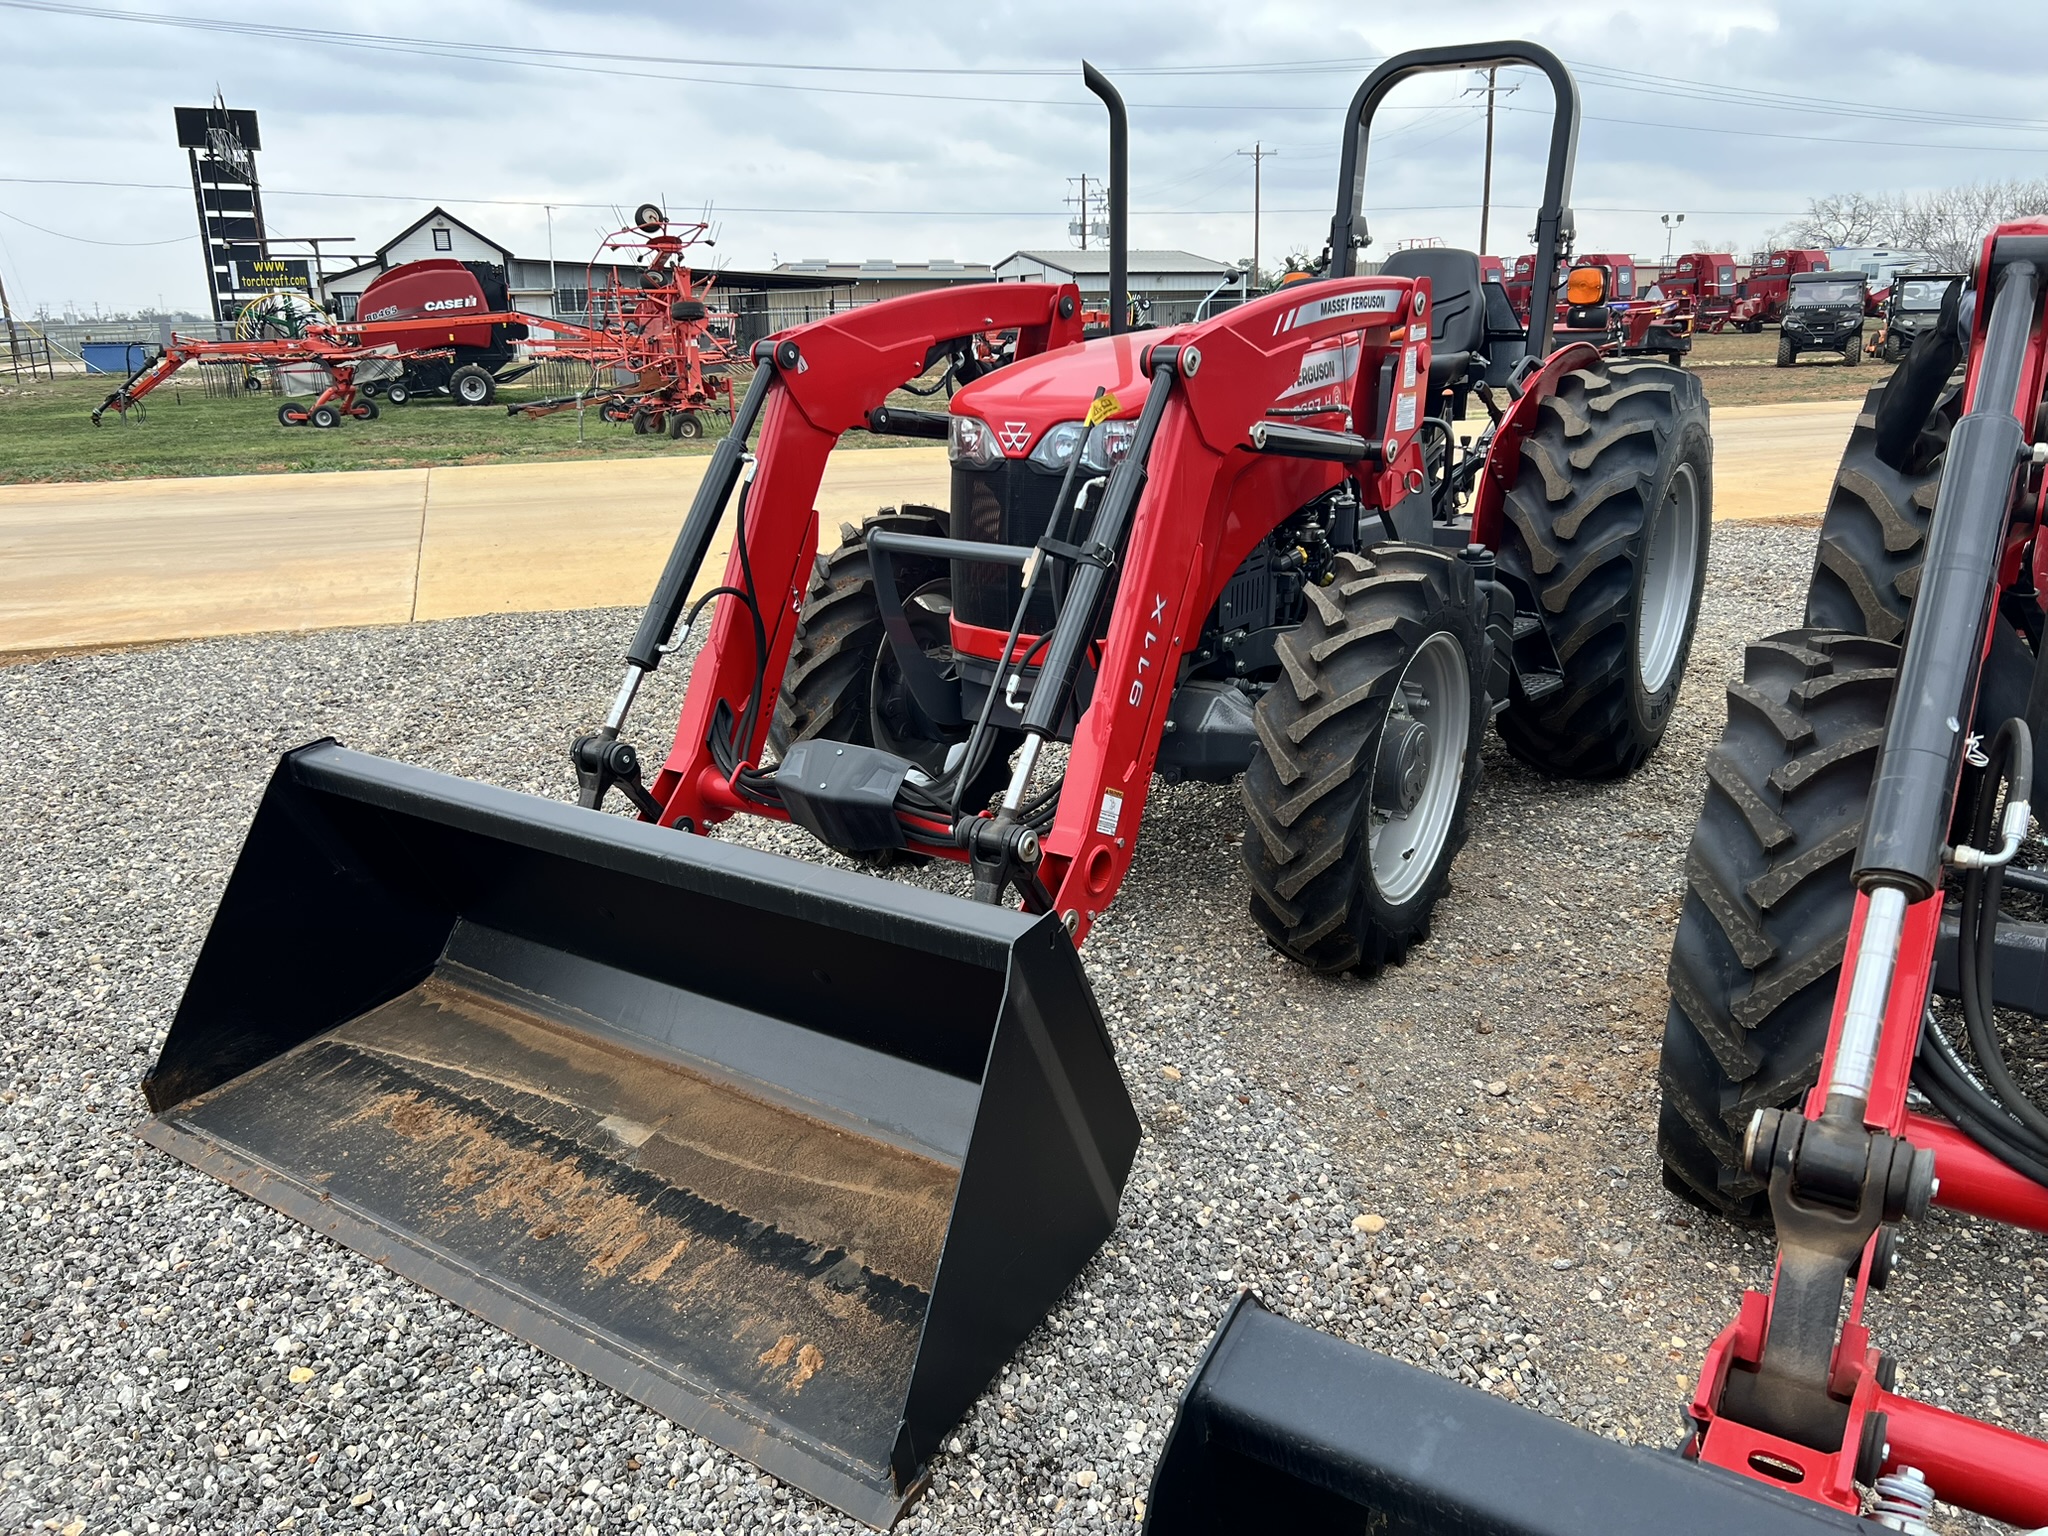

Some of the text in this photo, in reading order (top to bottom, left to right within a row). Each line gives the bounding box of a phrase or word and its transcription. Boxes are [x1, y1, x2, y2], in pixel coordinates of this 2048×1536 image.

[253, 261, 289, 272] www.
[241, 274, 308, 287] torchcraft.com
[424, 298, 464, 311] CASE
[1320, 295, 1386, 316] MASSEY FERGUSON
[1129, 593, 1167, 707] 911X
